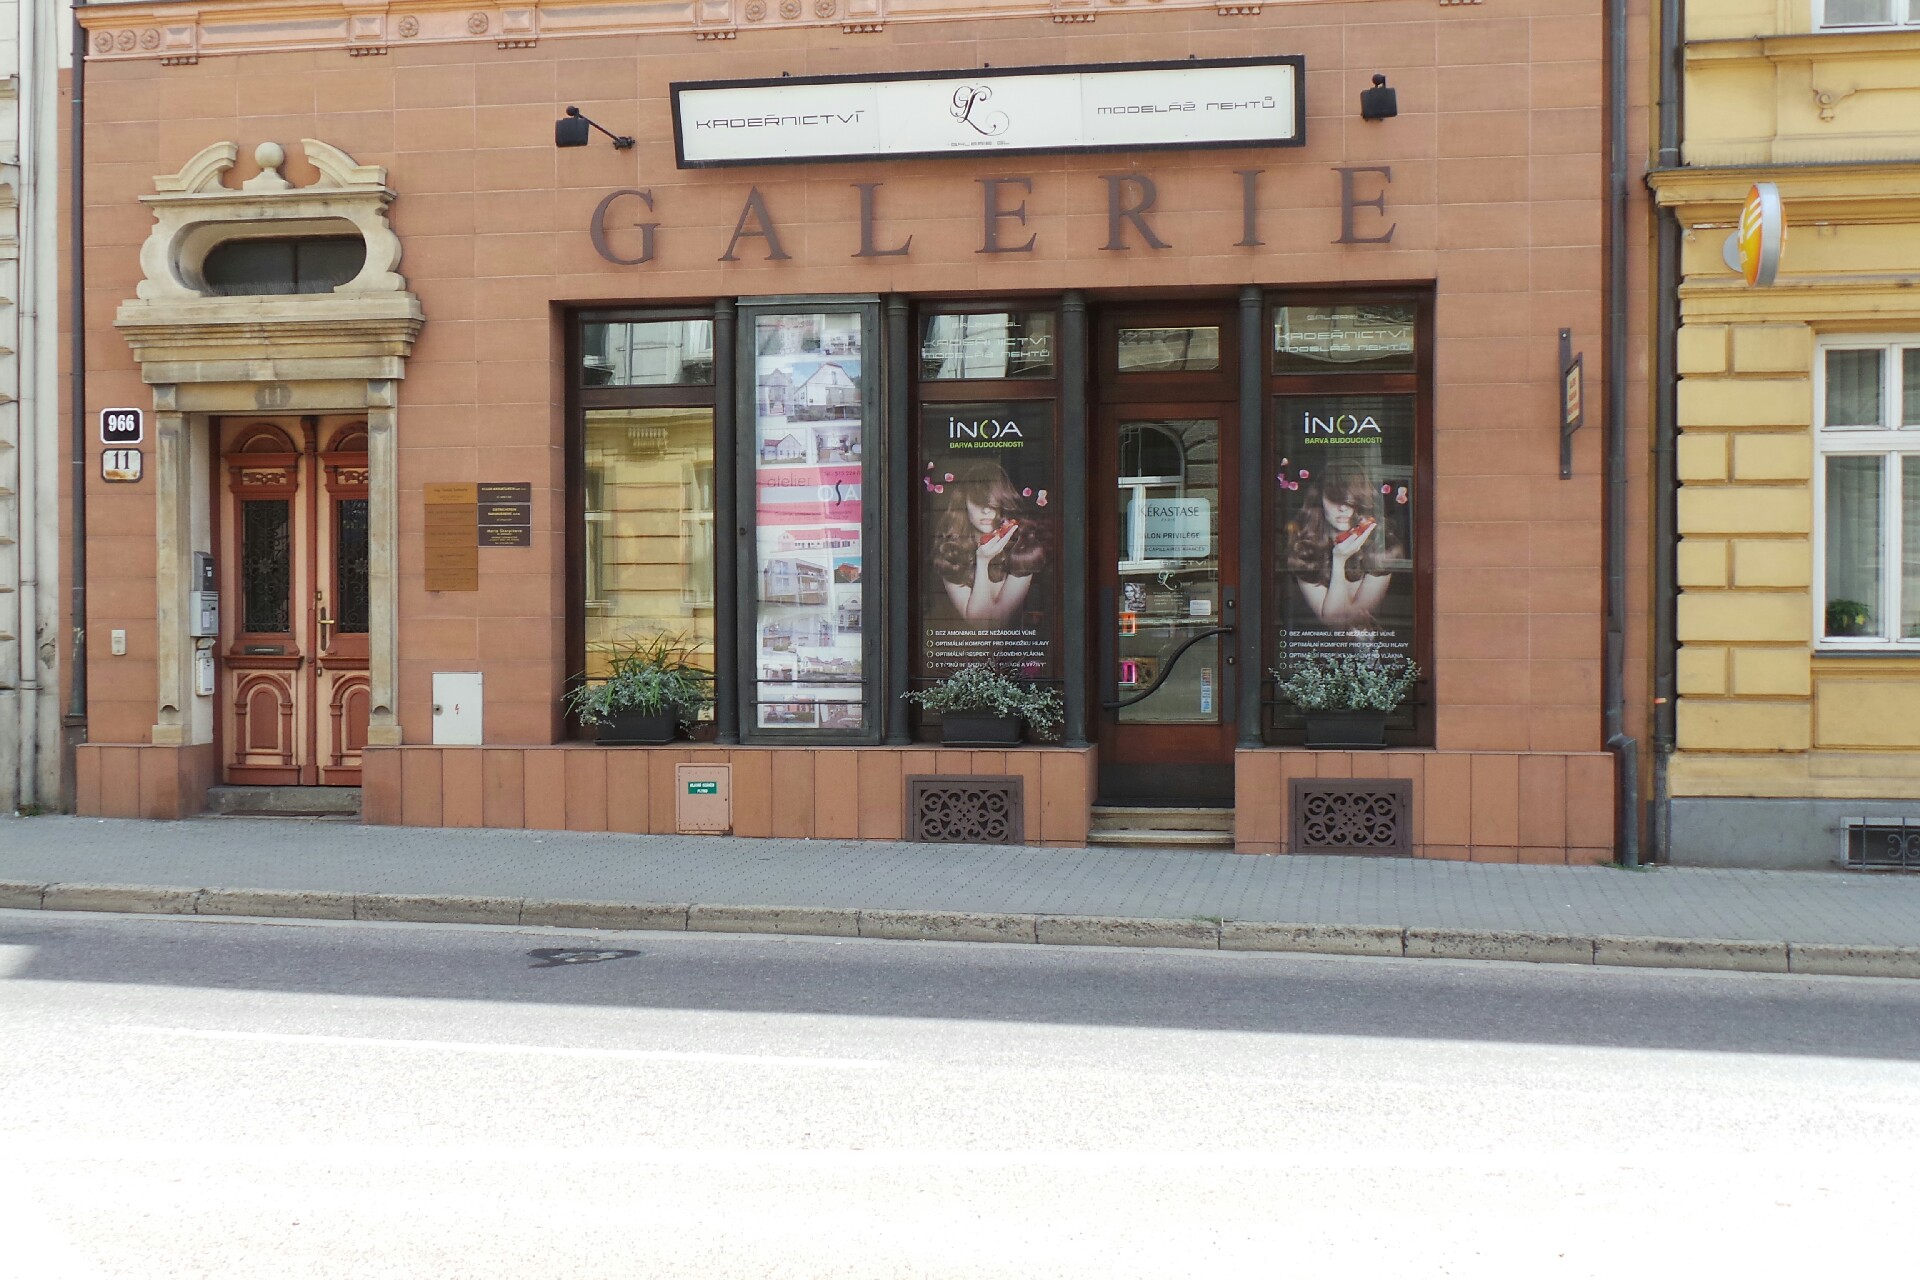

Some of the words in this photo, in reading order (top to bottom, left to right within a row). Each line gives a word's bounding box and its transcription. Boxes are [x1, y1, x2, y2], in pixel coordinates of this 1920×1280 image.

[1206, 96, 1276, 110] NEHTŮ
[589, 166, 1397, 266] GALERIE
[108, 414, 135, 432] 966
[973, 440, 1024, 448] BUDOUCNOSTI
[1304, 437, 1329, 445] BARVA
[113, 451, 130, 470] 11
[767, 472, 812, 488] atelier
